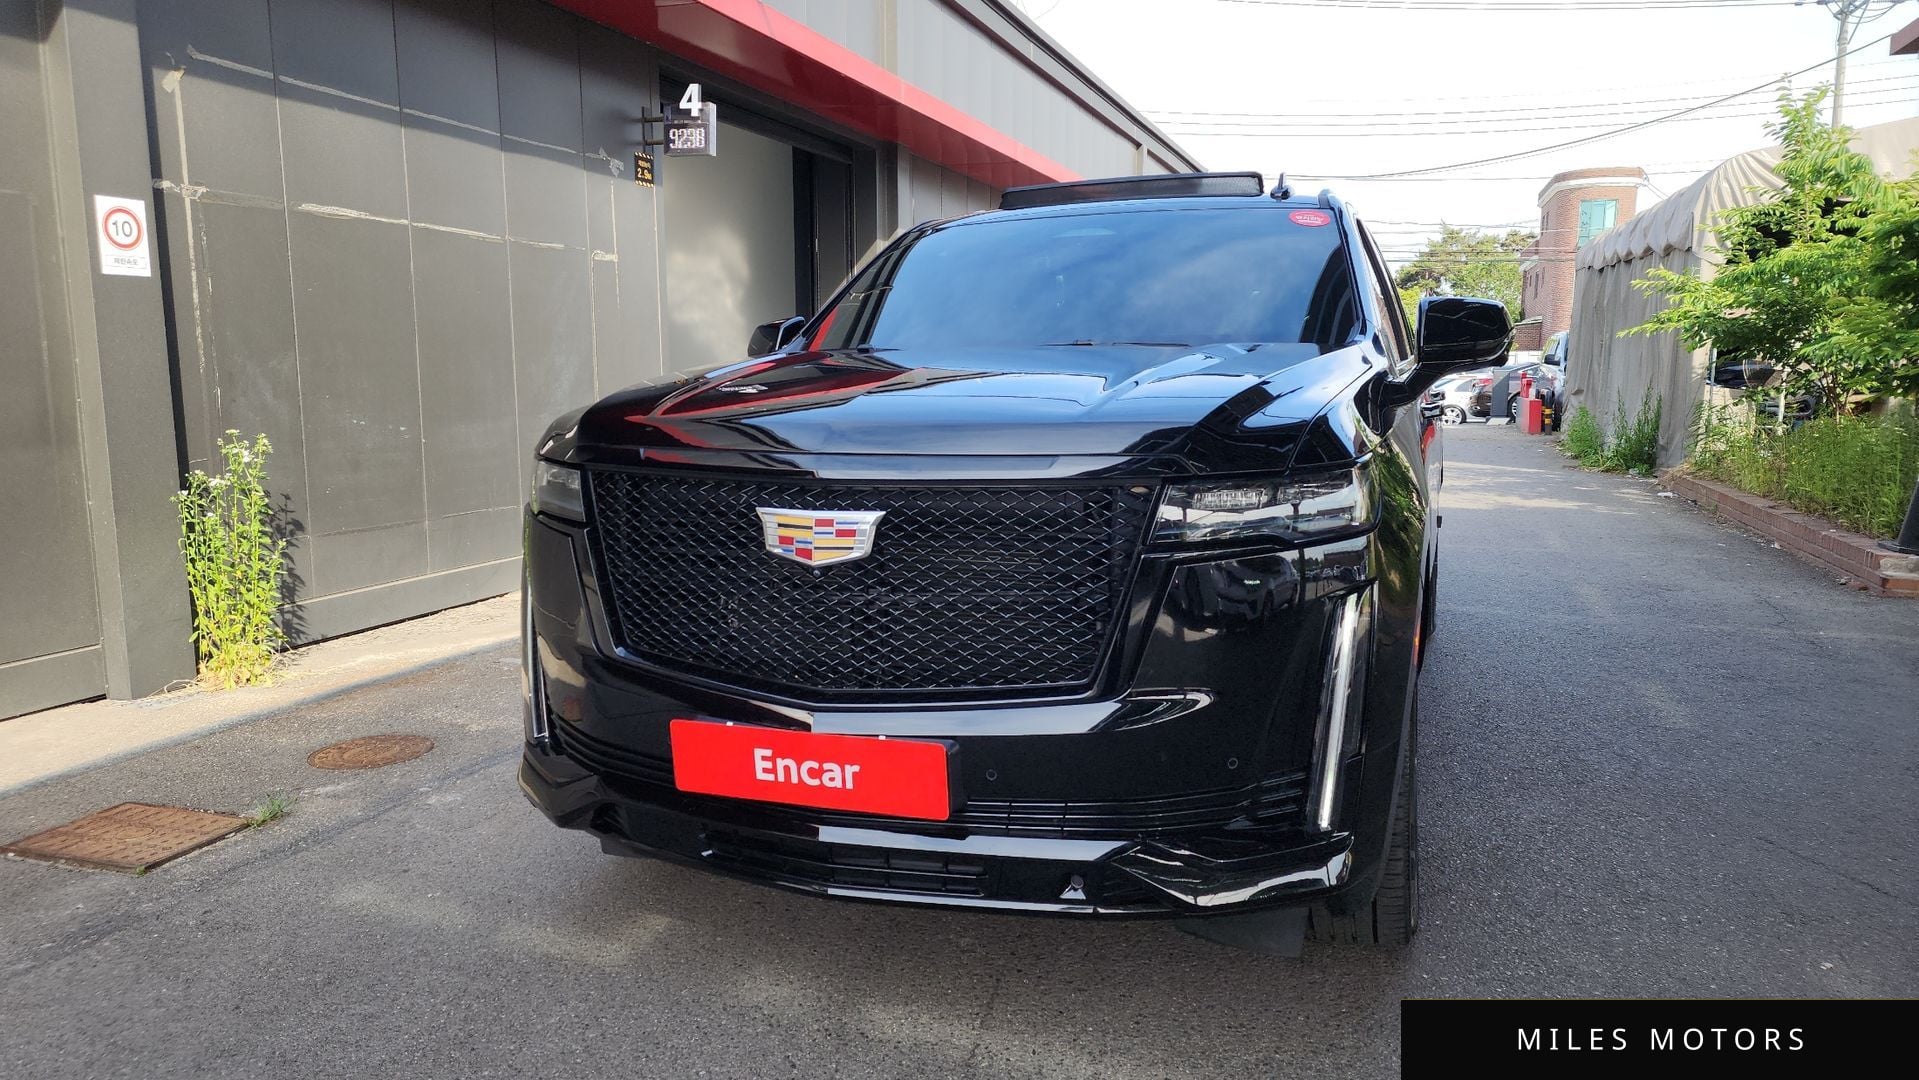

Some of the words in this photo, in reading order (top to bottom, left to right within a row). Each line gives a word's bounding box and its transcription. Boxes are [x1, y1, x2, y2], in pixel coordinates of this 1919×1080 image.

[679, 83, 701, 117] 4
[112, 220, 133, 237] 10
[753, 747, 861, 790] Encar
